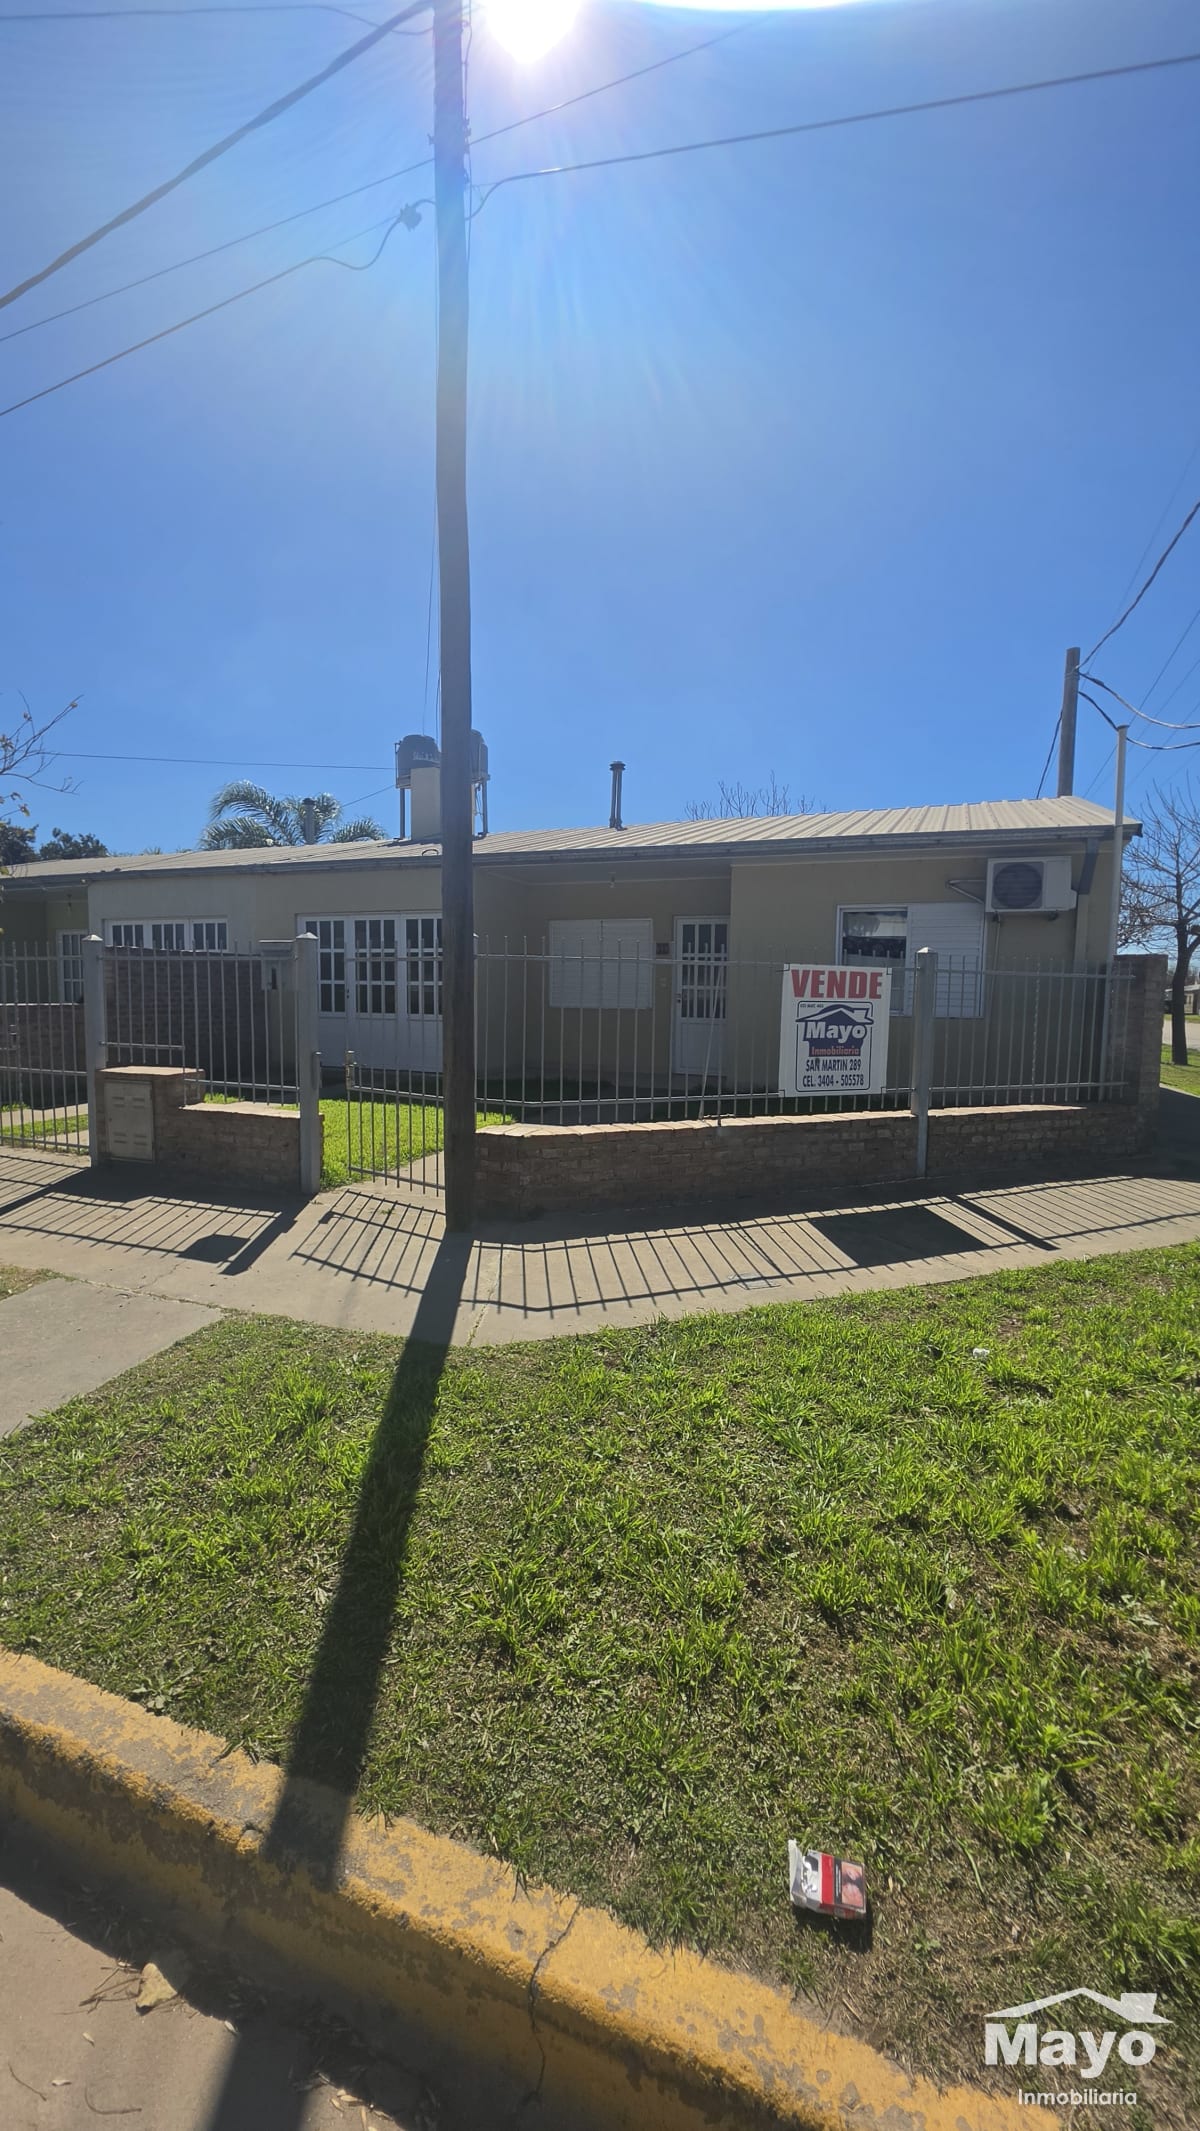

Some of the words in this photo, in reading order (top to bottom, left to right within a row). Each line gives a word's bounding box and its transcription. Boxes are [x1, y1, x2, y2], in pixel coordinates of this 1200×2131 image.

[791, 969, 883, 999] VENDE
[805, 1021, 866, 1043] Mayo
[811, 1045, 859, 1056] Inmobiliaria
[805, 1059, 820, 1072] SAN
[822, 1059, 847, 1071] MARTIN
[849, 1058, 861, 1071] 289
[818, 1074, 834, 1087] 3404
[840, 1074, 865, 1086] 505578
